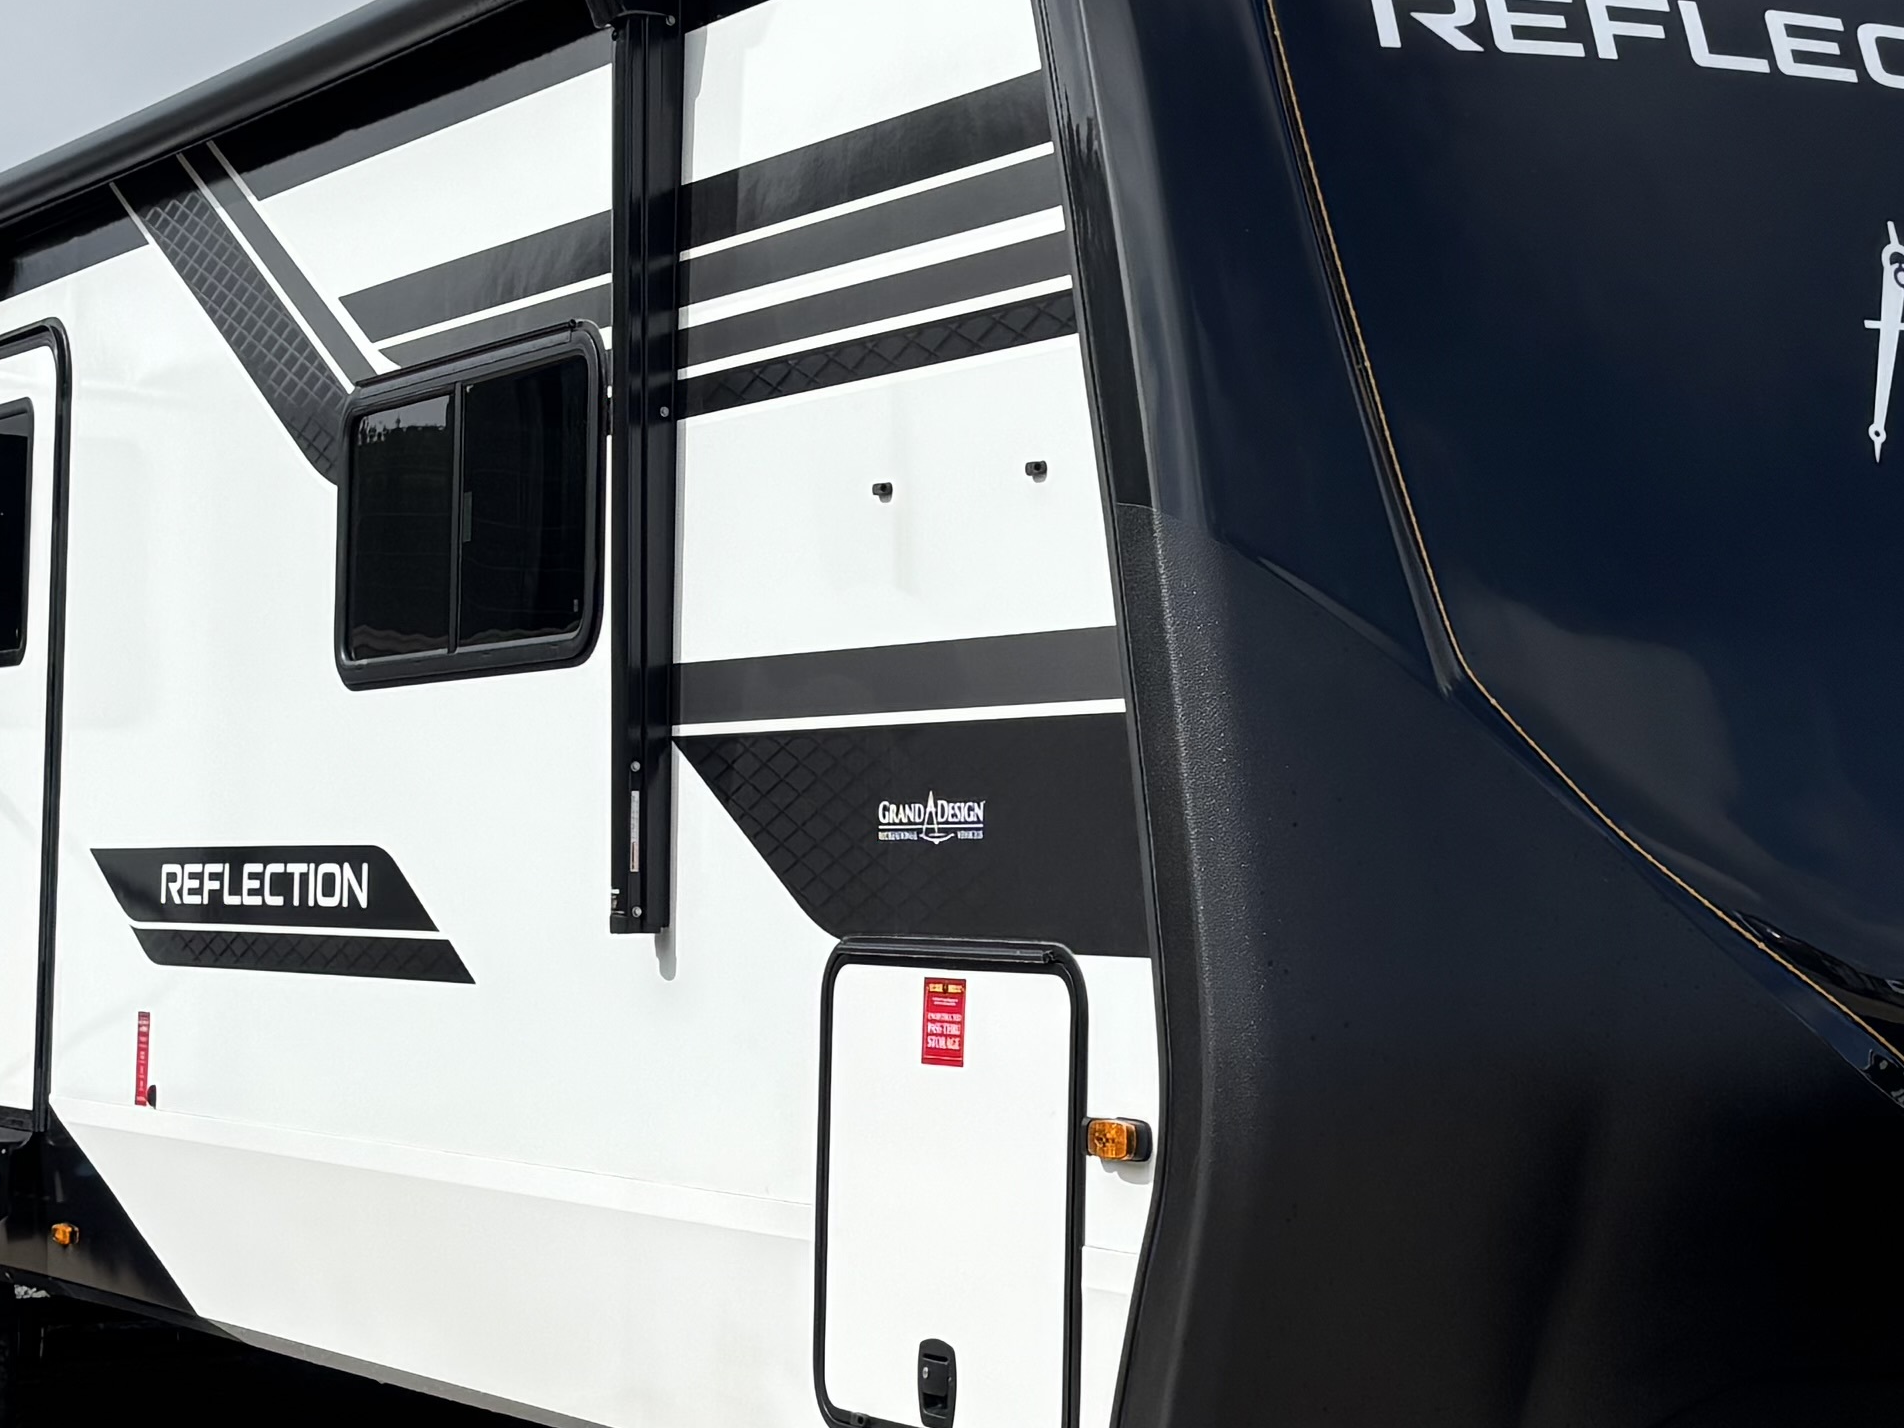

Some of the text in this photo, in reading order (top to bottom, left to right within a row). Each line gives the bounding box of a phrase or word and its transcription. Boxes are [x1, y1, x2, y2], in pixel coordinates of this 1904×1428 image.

[878, 800, 984, 823] GRAND DESIGN
[160, 862, 368, 909] REFLECTION
